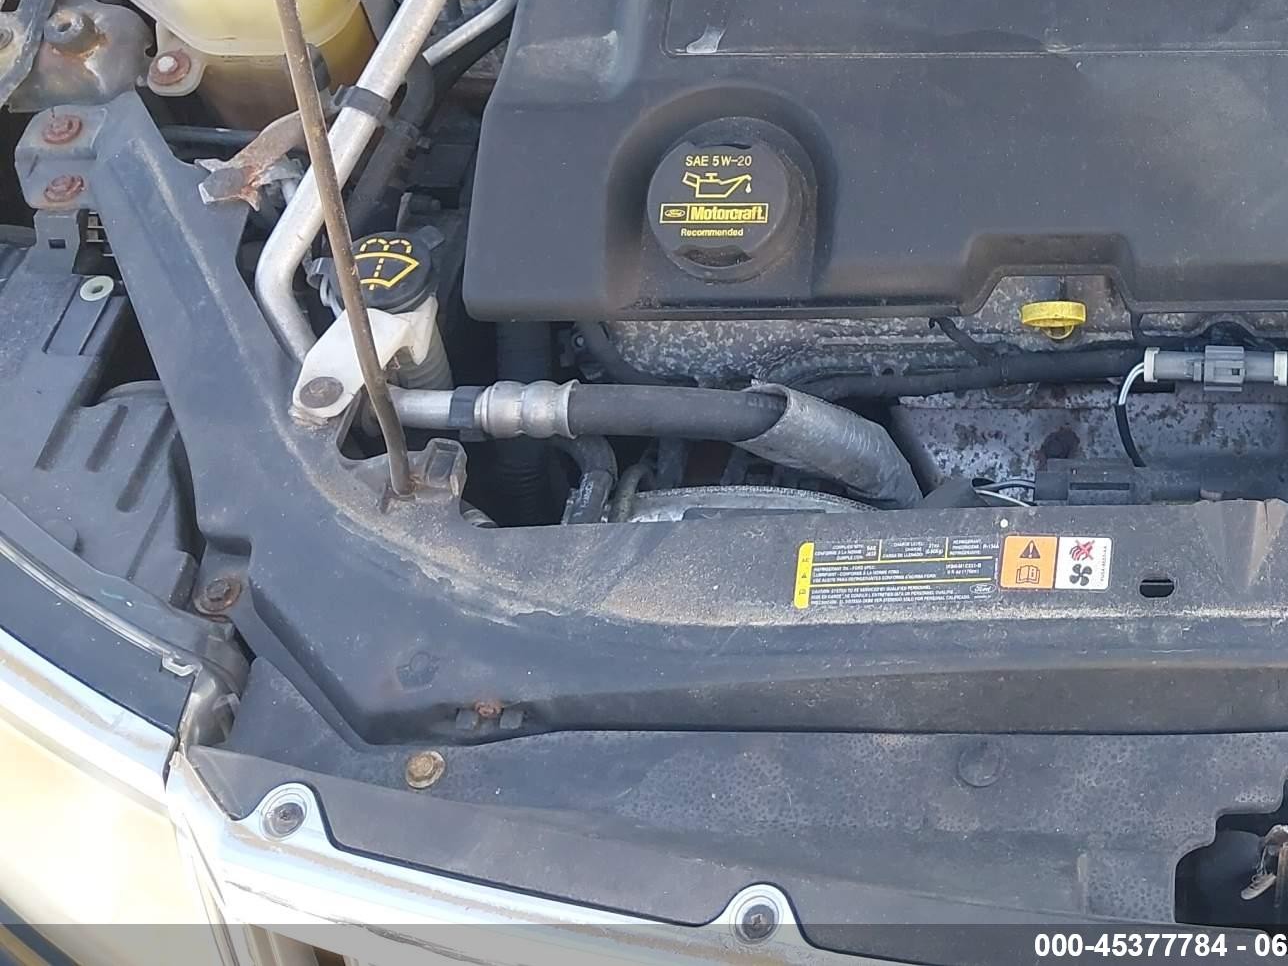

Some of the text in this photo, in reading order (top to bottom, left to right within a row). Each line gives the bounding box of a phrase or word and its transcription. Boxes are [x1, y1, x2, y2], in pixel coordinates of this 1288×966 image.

[685, 156, 709, 167] SAE
[690, 206, 765, 221] Motorcraft
[681, 228, 744, 238] Recommended
